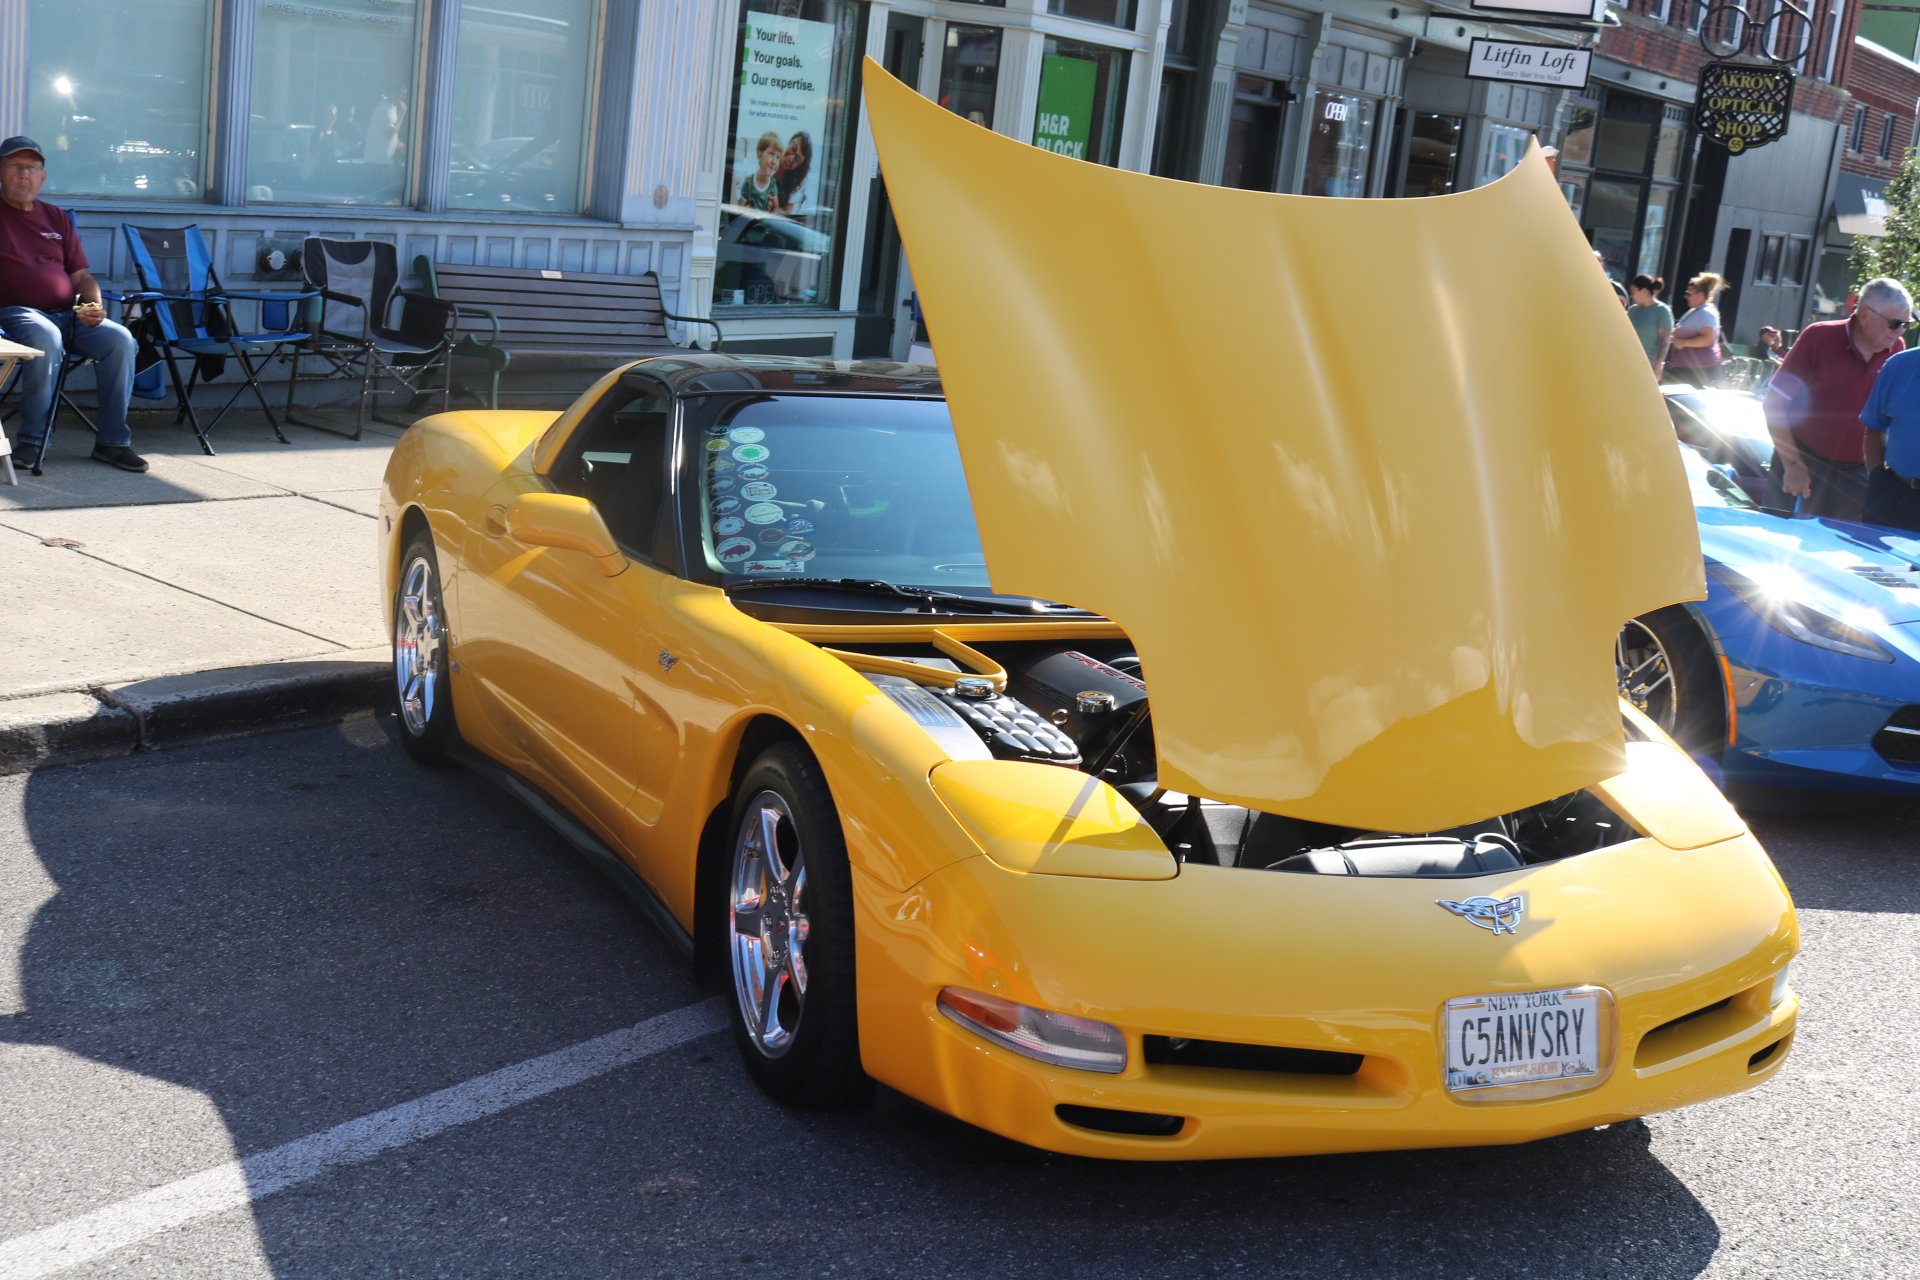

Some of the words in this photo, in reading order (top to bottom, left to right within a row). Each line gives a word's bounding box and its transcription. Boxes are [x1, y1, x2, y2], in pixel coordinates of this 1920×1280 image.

[755, 28, 777, 42] Your
[778, 31, 796, 45] life.
[753, 50, 774, 64] Your
[776, 55, 803, 68] goals.
[1482, 45, 1532, 69] Litfin
[1539, 51, 1577, 74] Loft
[751, 72, 769, 86] Our
[770, 77, 815, 92] expertise.
[1717, 74, 1776, 90] AKRON
[1325, 102, 1348, 121] OPEN
[1708, 97, 1776, 115] OPTICAL
[1038, 112, 1070, 136] H&R
[1715, 120, 1763, 137] SHOP
[1488, 996, 1519, 1012] NEW
[1525, 992, 1562, 1008] YORK
[1462, 1008, 1584, 1067] C5ANVSRY
